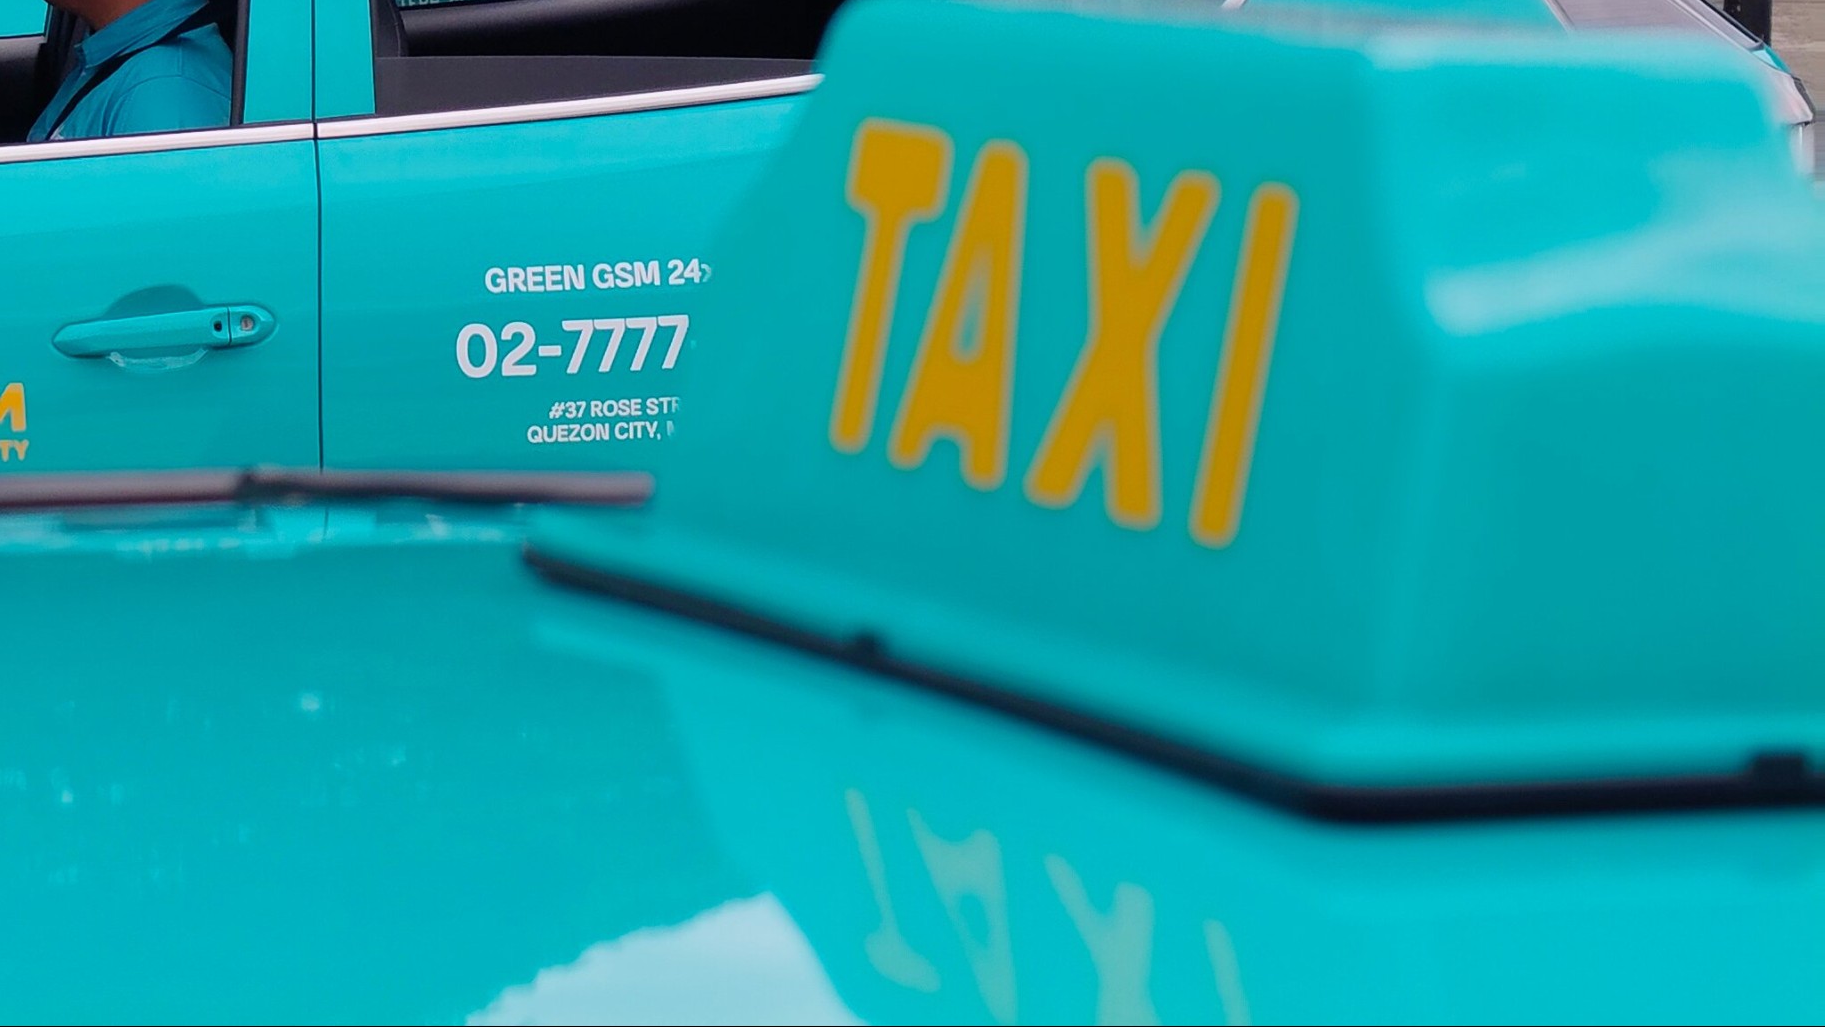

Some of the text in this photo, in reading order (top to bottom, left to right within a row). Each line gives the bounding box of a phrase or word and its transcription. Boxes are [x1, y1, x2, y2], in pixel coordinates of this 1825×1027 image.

[485, 264, 585, 294] GREEN
[592, 260, 661, 290] GSM
[829, 116, 1300, 550] TAXI
[549, 401, 586, 420] #37
[590, 398, 642, 417] ROSE
[527, 423, 610, 444] QUEZON
[614, 421, 661, 441] CITY,
